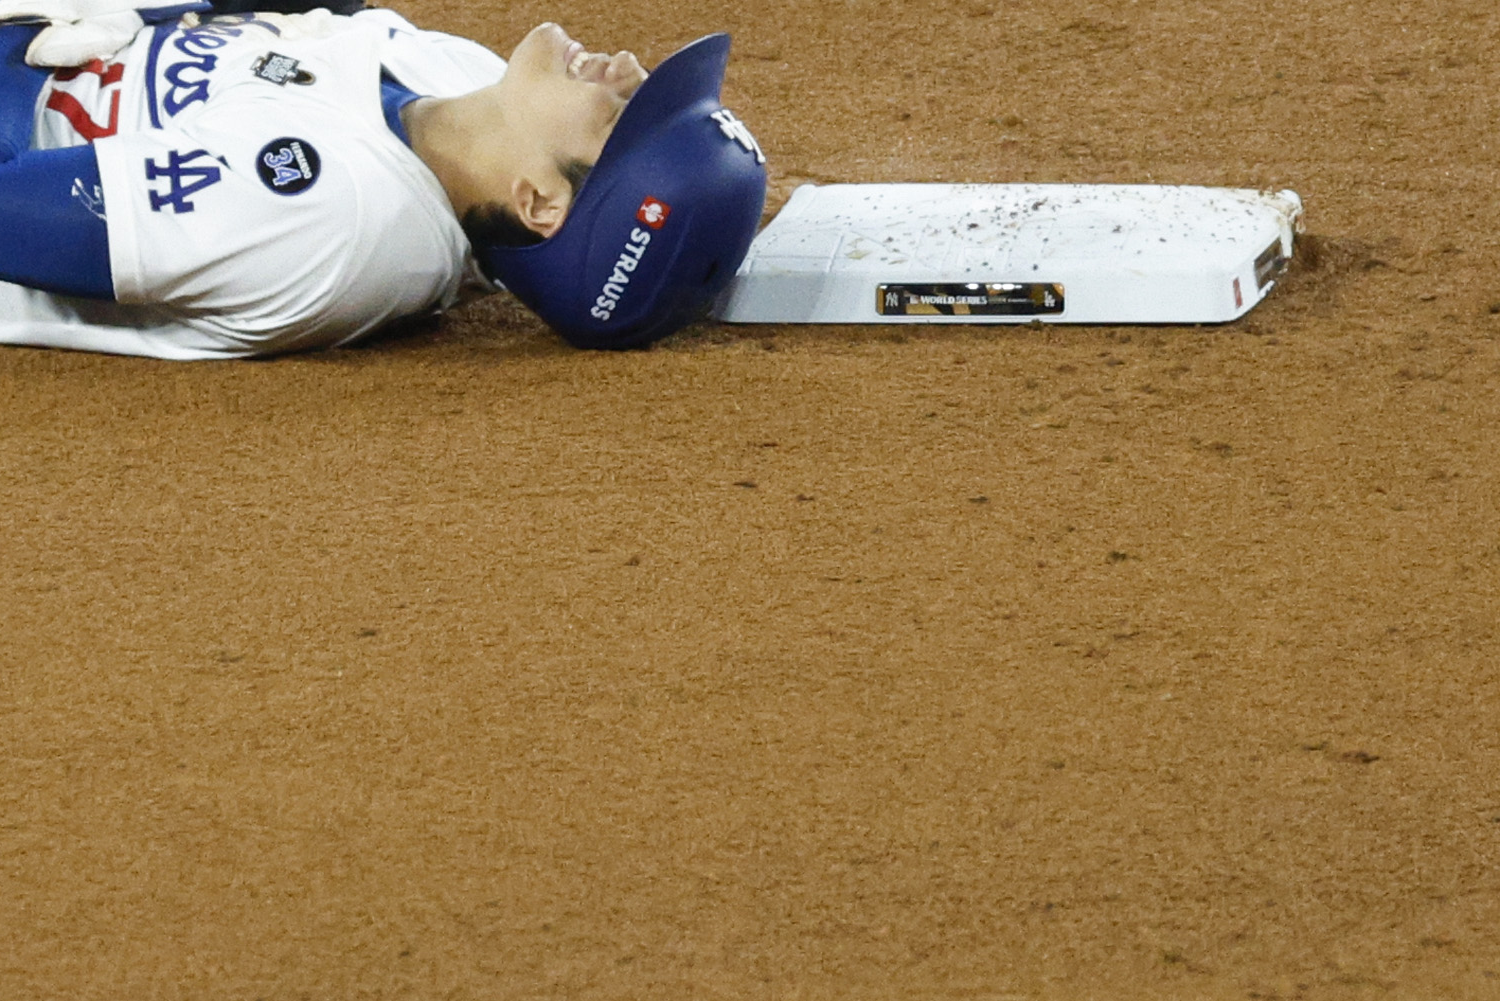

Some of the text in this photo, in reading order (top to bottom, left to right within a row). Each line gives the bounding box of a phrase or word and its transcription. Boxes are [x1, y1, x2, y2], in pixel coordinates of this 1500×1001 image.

[263, 147, 302, 186] 34
[590, 227, 651, 321] STRAUSS
[920, 295, 955, 304] WORLD
[956, 295, 988, 305] SERIES
